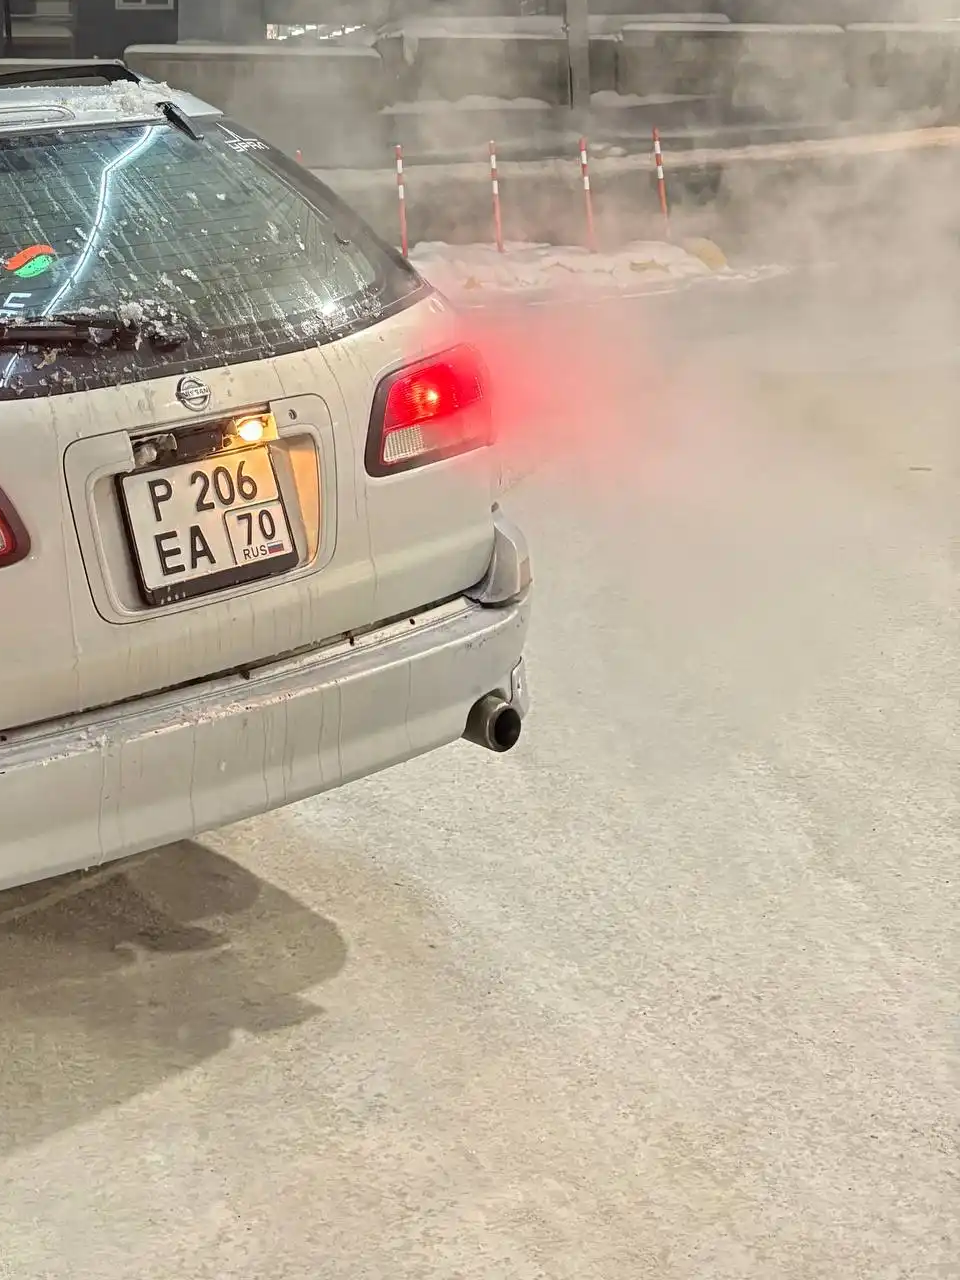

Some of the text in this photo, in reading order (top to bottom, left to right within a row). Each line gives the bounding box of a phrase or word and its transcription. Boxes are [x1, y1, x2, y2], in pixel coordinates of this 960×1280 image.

[190, 460, 258, 513] 206
[237, 509, 276, 546] 70
[243, 544, 268, 560] RUS
